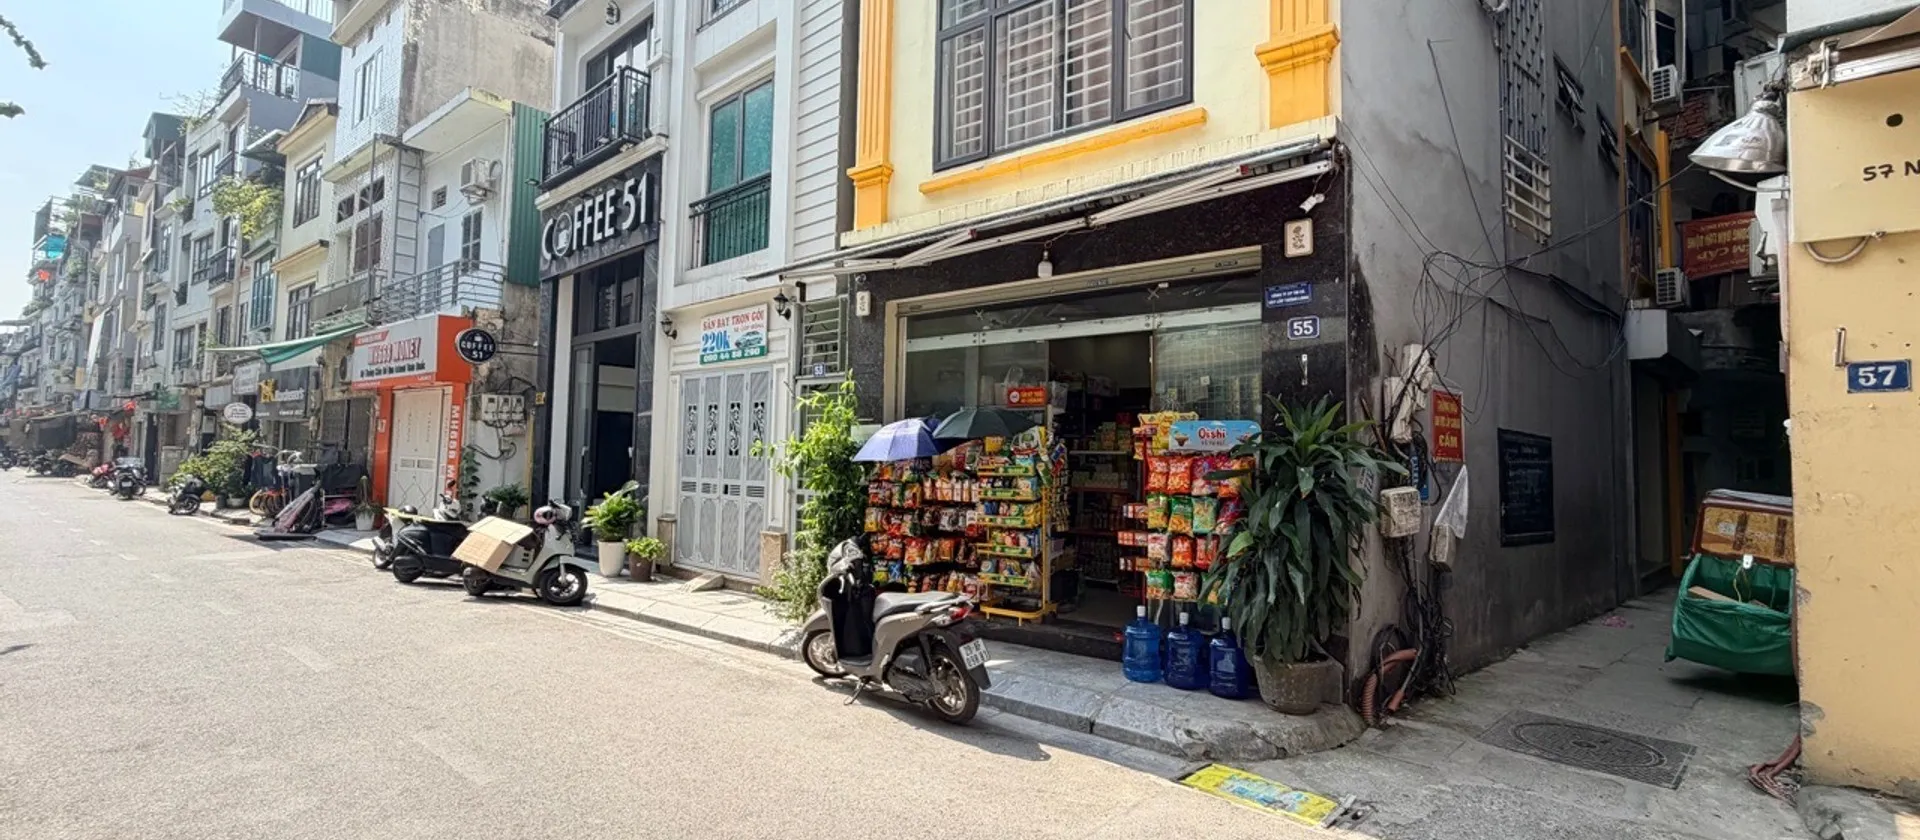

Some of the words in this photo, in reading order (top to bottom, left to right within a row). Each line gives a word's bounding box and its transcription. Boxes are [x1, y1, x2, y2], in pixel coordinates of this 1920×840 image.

[1863, 164, 1895, 181] 57
[541, 187, 616, 262] COFFEE
[621, 172, 649, 230] 51
[1293, 319, 1314, 336] 55
[460, 340, 494, 352] COFFEE
[472, 350, 483, 359] 51
[1858, 364, 1898, 387] 57
[1198, 427, 1227, 440] Oishi
